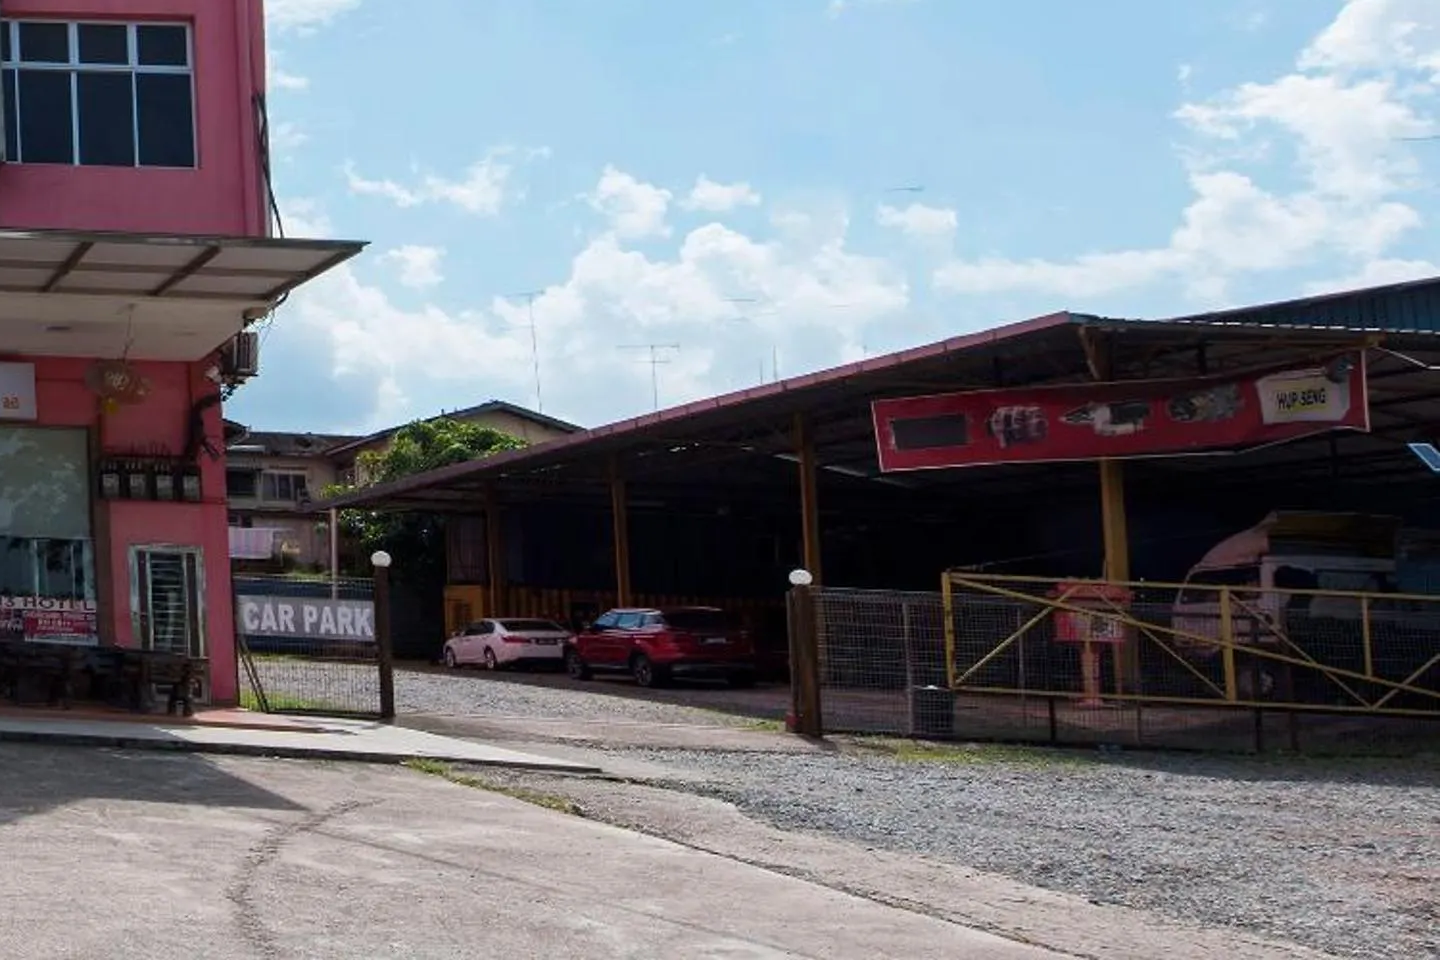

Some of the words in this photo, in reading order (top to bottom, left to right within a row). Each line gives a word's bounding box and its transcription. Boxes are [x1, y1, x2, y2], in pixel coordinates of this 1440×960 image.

[22, 596, 94, 611] HOTEL
[243, 601, 296, 633] CAR
[303, 604, 374, 637] PARK
